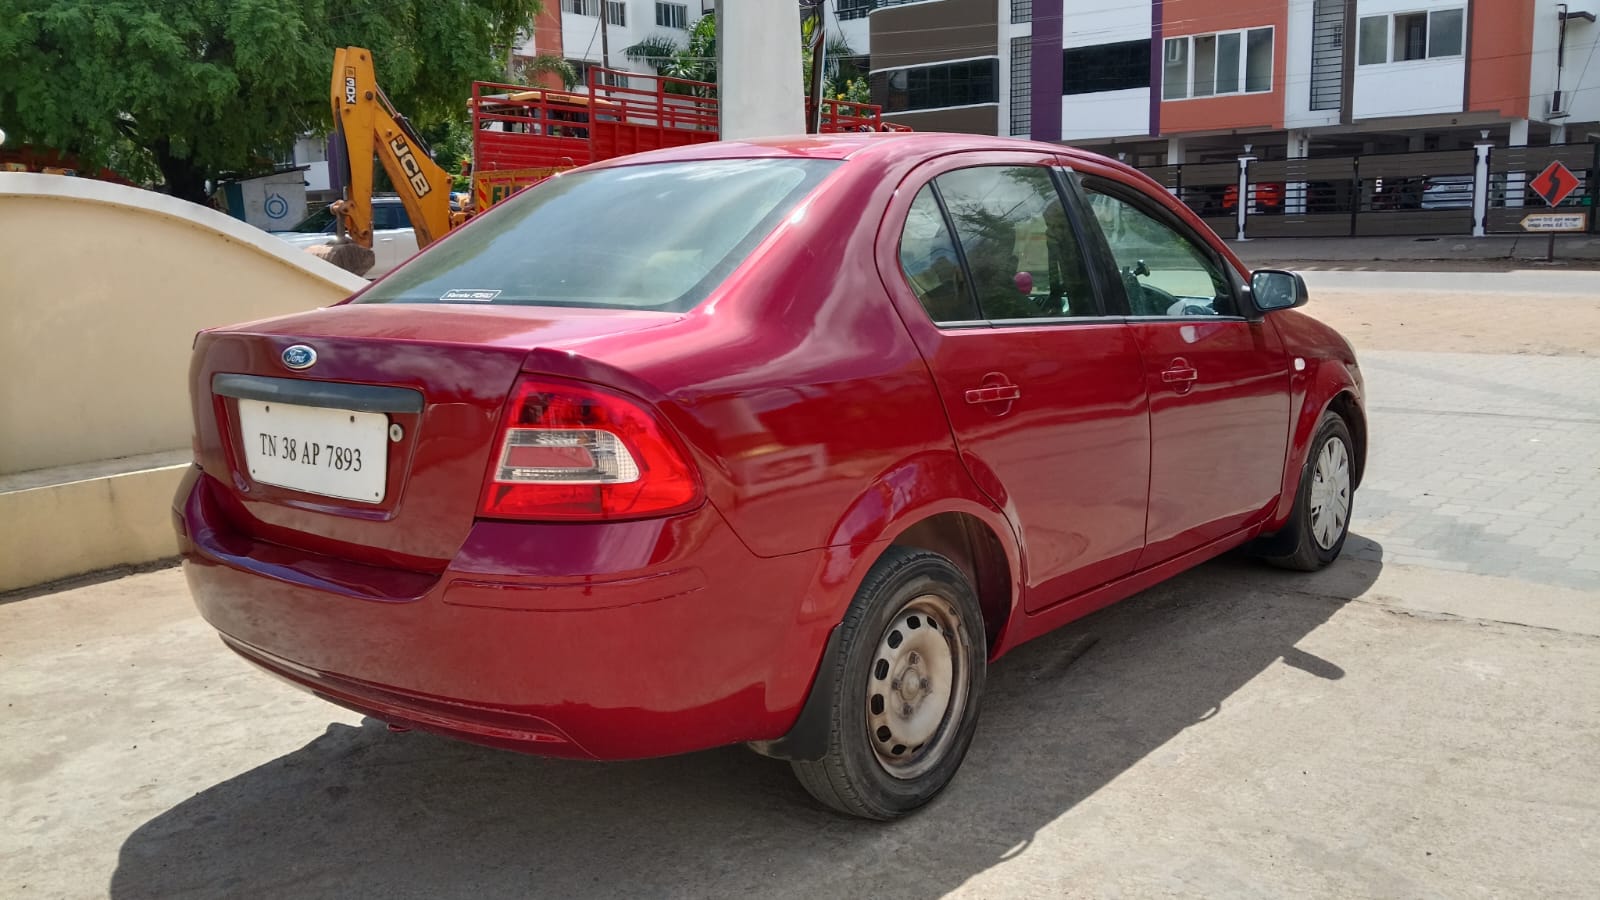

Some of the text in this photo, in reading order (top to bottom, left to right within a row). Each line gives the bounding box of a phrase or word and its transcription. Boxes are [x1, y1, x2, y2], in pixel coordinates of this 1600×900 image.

[346, 77, 356, 103] 3DX
[391, 139, 430, 197] JCB
[260, 433, 362, 472] TN 38 AP 7893
